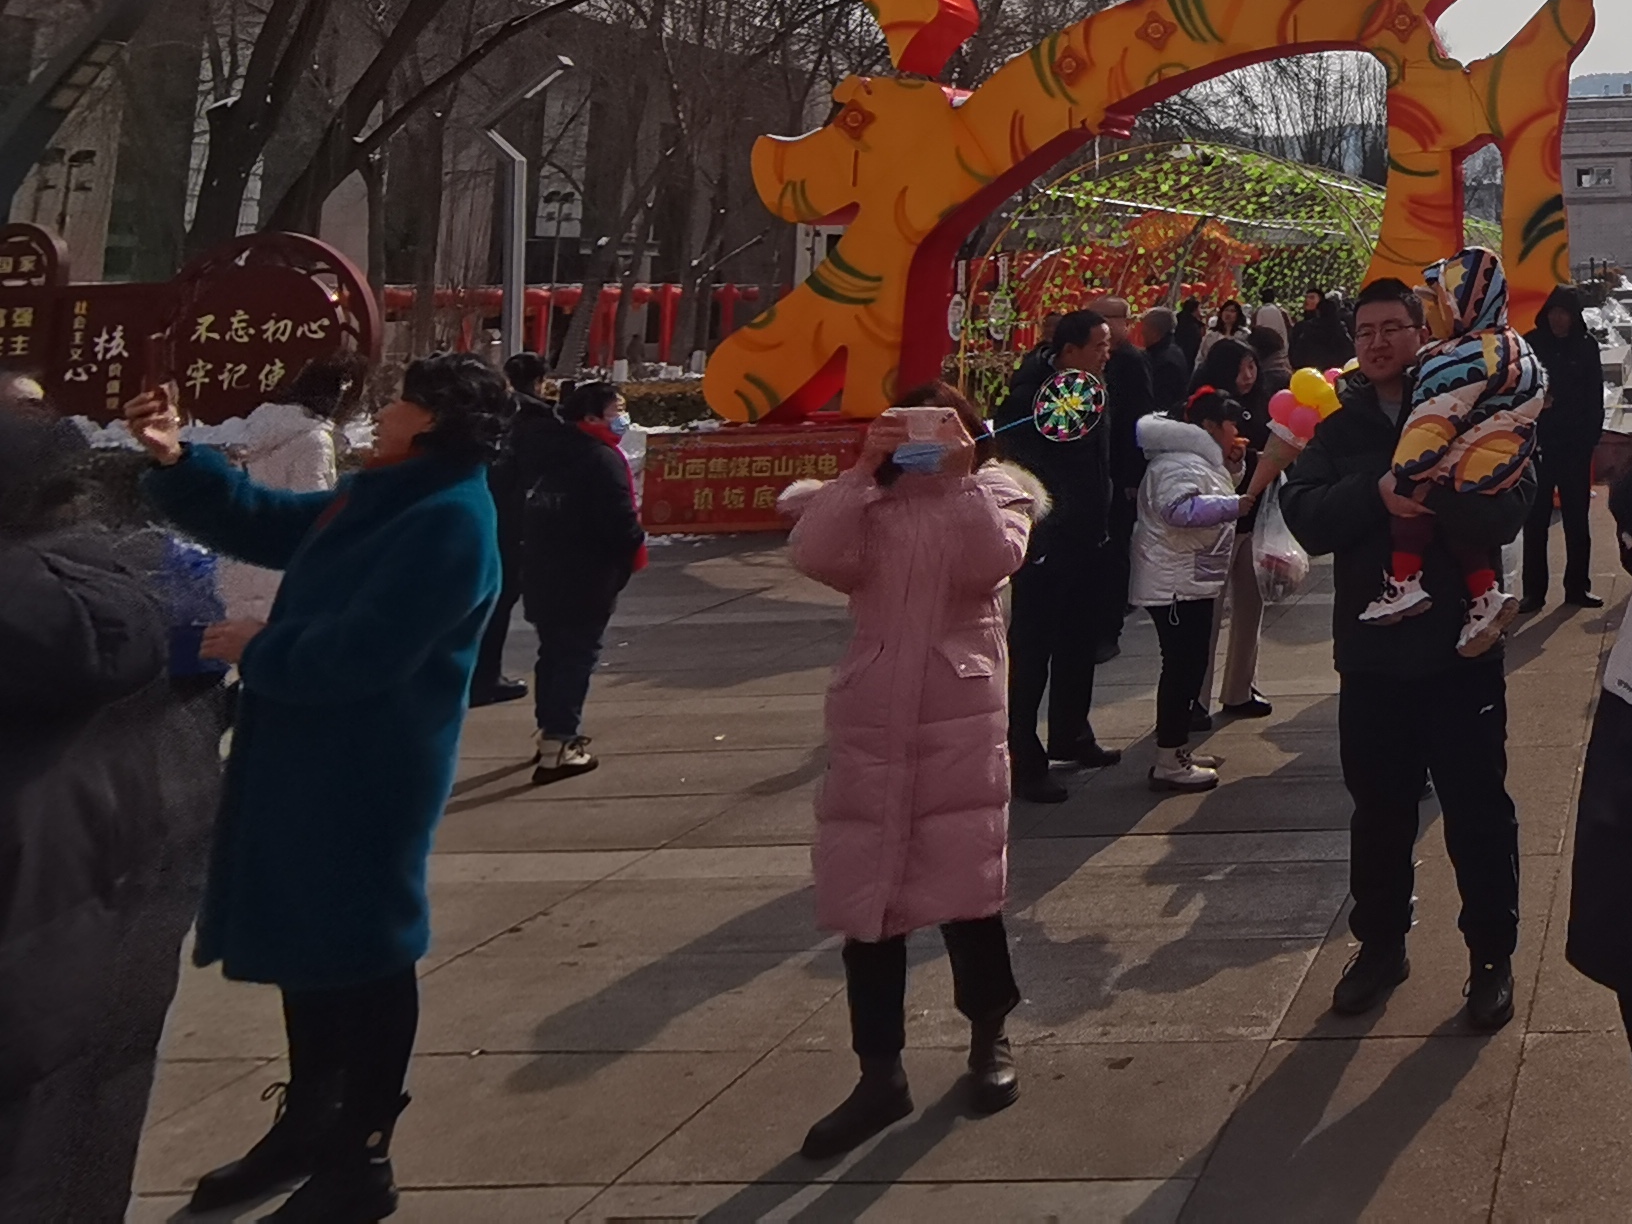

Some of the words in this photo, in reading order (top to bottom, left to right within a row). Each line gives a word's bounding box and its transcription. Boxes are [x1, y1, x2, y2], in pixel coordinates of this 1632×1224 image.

[189, 309, 331, 345] 不忘初心
[0, 334, 31, 356] 主
[185, 359, 287, 400] 牢记使
[663, 453, 839, 480] 山西焦煤西山煤电
